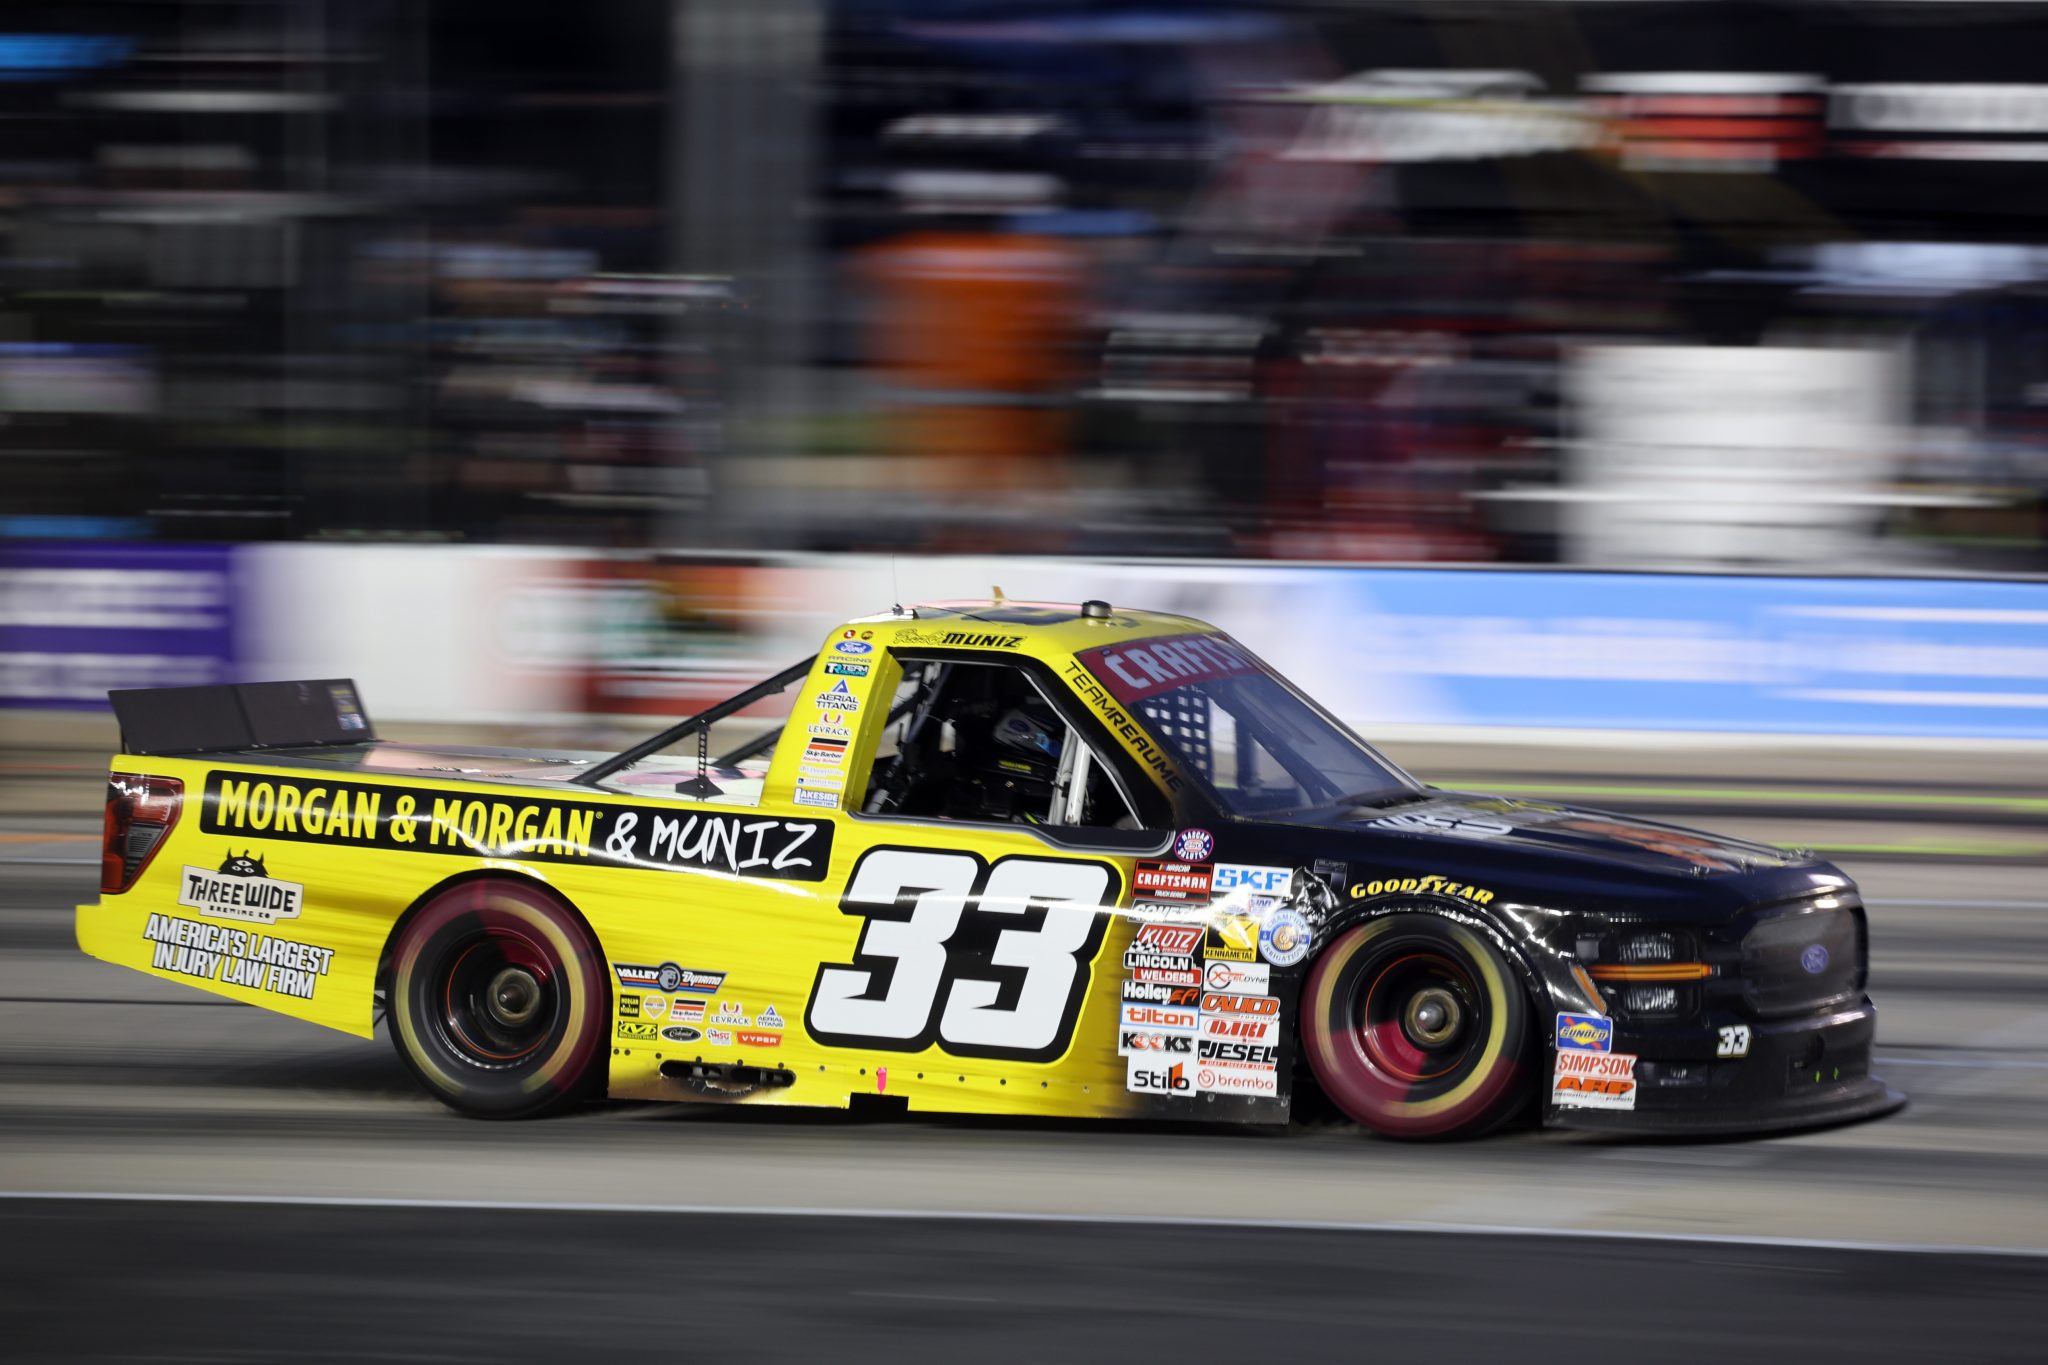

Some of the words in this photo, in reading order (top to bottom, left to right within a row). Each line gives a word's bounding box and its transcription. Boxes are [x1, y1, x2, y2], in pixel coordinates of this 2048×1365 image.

[942, 631, 1026, 648] MUNIZ
[816, 700, 857, 711] TITANS
[818, 693, 858, 704] AERIAL
[808, 725, 849, 736] LEVRACK
[216, 779, 382, 840] MORGAN
[389, 795, 418, 844] &
[429, 798, 595, 858] MORGAN
[605, 811, 639, 861] &
[649, 814, 818, 871] MUNIZ
[1137, 872, 1208, 890] CRAFTSMAN
[1216, 867, 1292, 891] SKF
[1350, 875, 1495, 905] GOODYEAR
[209, 905, 254, 917] BREWING
[143, 913, 248, 959] AMERICA'S
[248, 932, 335, 976] LARGEST
[1140, 928, 1197, 949] KLOTZ
[806, 846, 1114, 1056] 33
[1204, 948, 1253, 961] KENNAMETAL
[152, 939, 221, 980] INJURY
[221, 955, 268, 990] LAW
[266, 965, 317, 1000] FIRM
[1127, 953, 1189, 970] LINCOLN
[616, 968, 660, 980] VALLEY
[1140, 968, 1194, 984] WELDERS
[1124, 980, 1172, 1006] Holley
[1201, 995, 1280, 1016] CALICO
[711, 1016, 750, 1025] LEVRACK
[1126, 1007, 1194, 1027] tilton
[742, 1035, 778, 1044] VYPER
[1121, 1032, 1193, 1054] KOOKS
[1718, 1025, 1750, 1058] 33
[1199, 1041, 1278, 1064] JESEL
[1559, 1054, 1632, 1076] SIMPSON
[1133, 1061, 1190, 1091] Stilo
[1218, 1074, 1274, 1089] brembo
